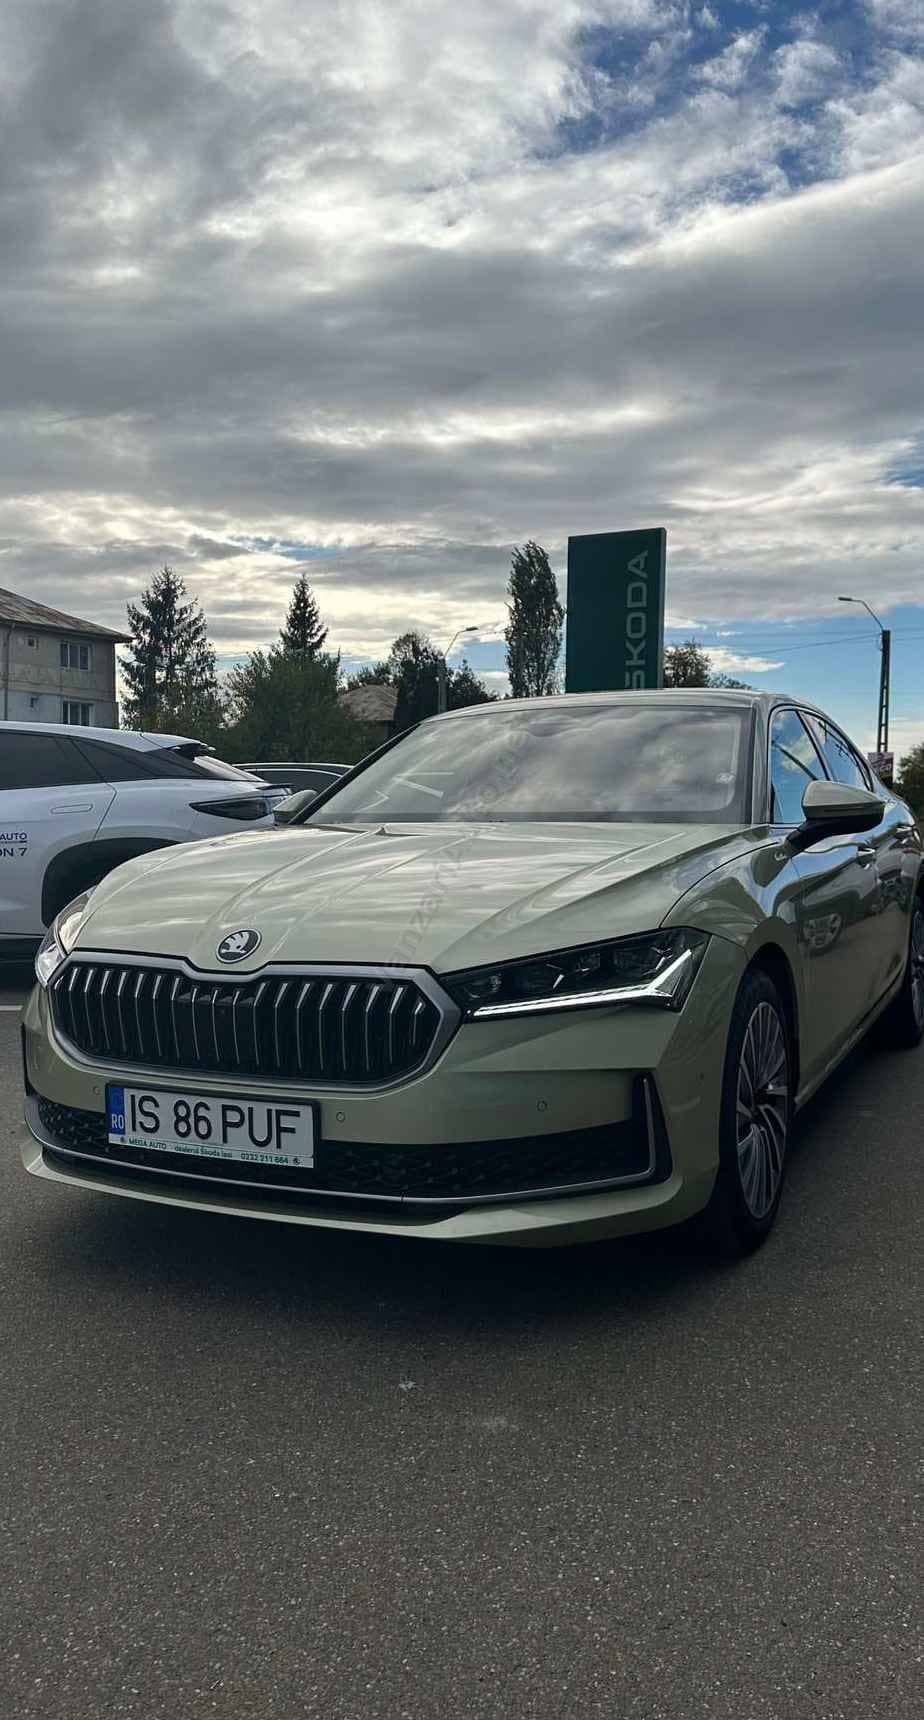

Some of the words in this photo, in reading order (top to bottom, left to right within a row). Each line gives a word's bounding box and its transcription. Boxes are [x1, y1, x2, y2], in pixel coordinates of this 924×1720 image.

[0, 832, 28, 841] AUTO
[18, 847, 28, 857] 7
[111, 1113, 125, 1129] RO
[130, 1094, 160, 1134] IS
[173, 1099, 213, 1140] 86
[221, 1104, 300, 1149] PUF
[129, 1138, 147, 1147] MEGA
[149, 1140, 167, 1150] AUTO
